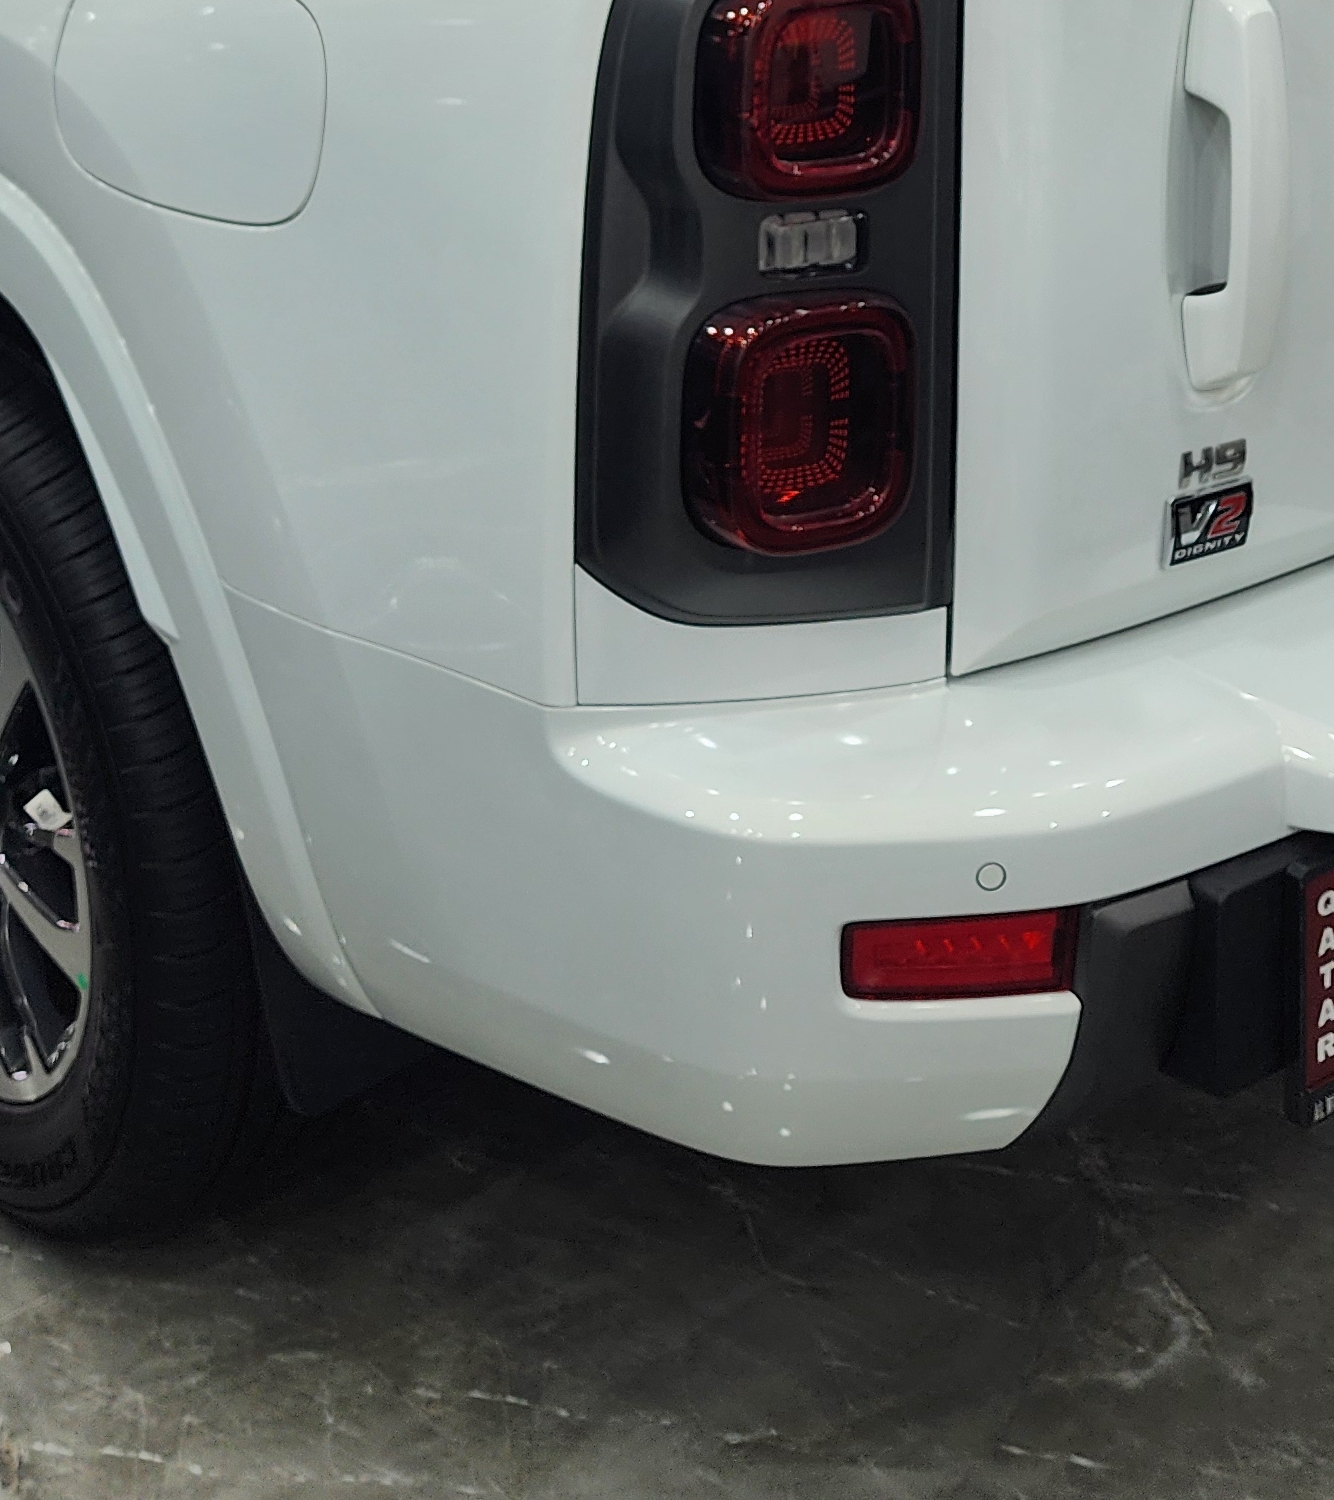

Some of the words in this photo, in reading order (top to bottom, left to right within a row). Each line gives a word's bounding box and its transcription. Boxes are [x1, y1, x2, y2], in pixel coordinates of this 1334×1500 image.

[1178, 438, 1246, 489] H9
[1178, 491, 1247, 546] V2
[1174, 531, 1245, 560] DIGNITY
